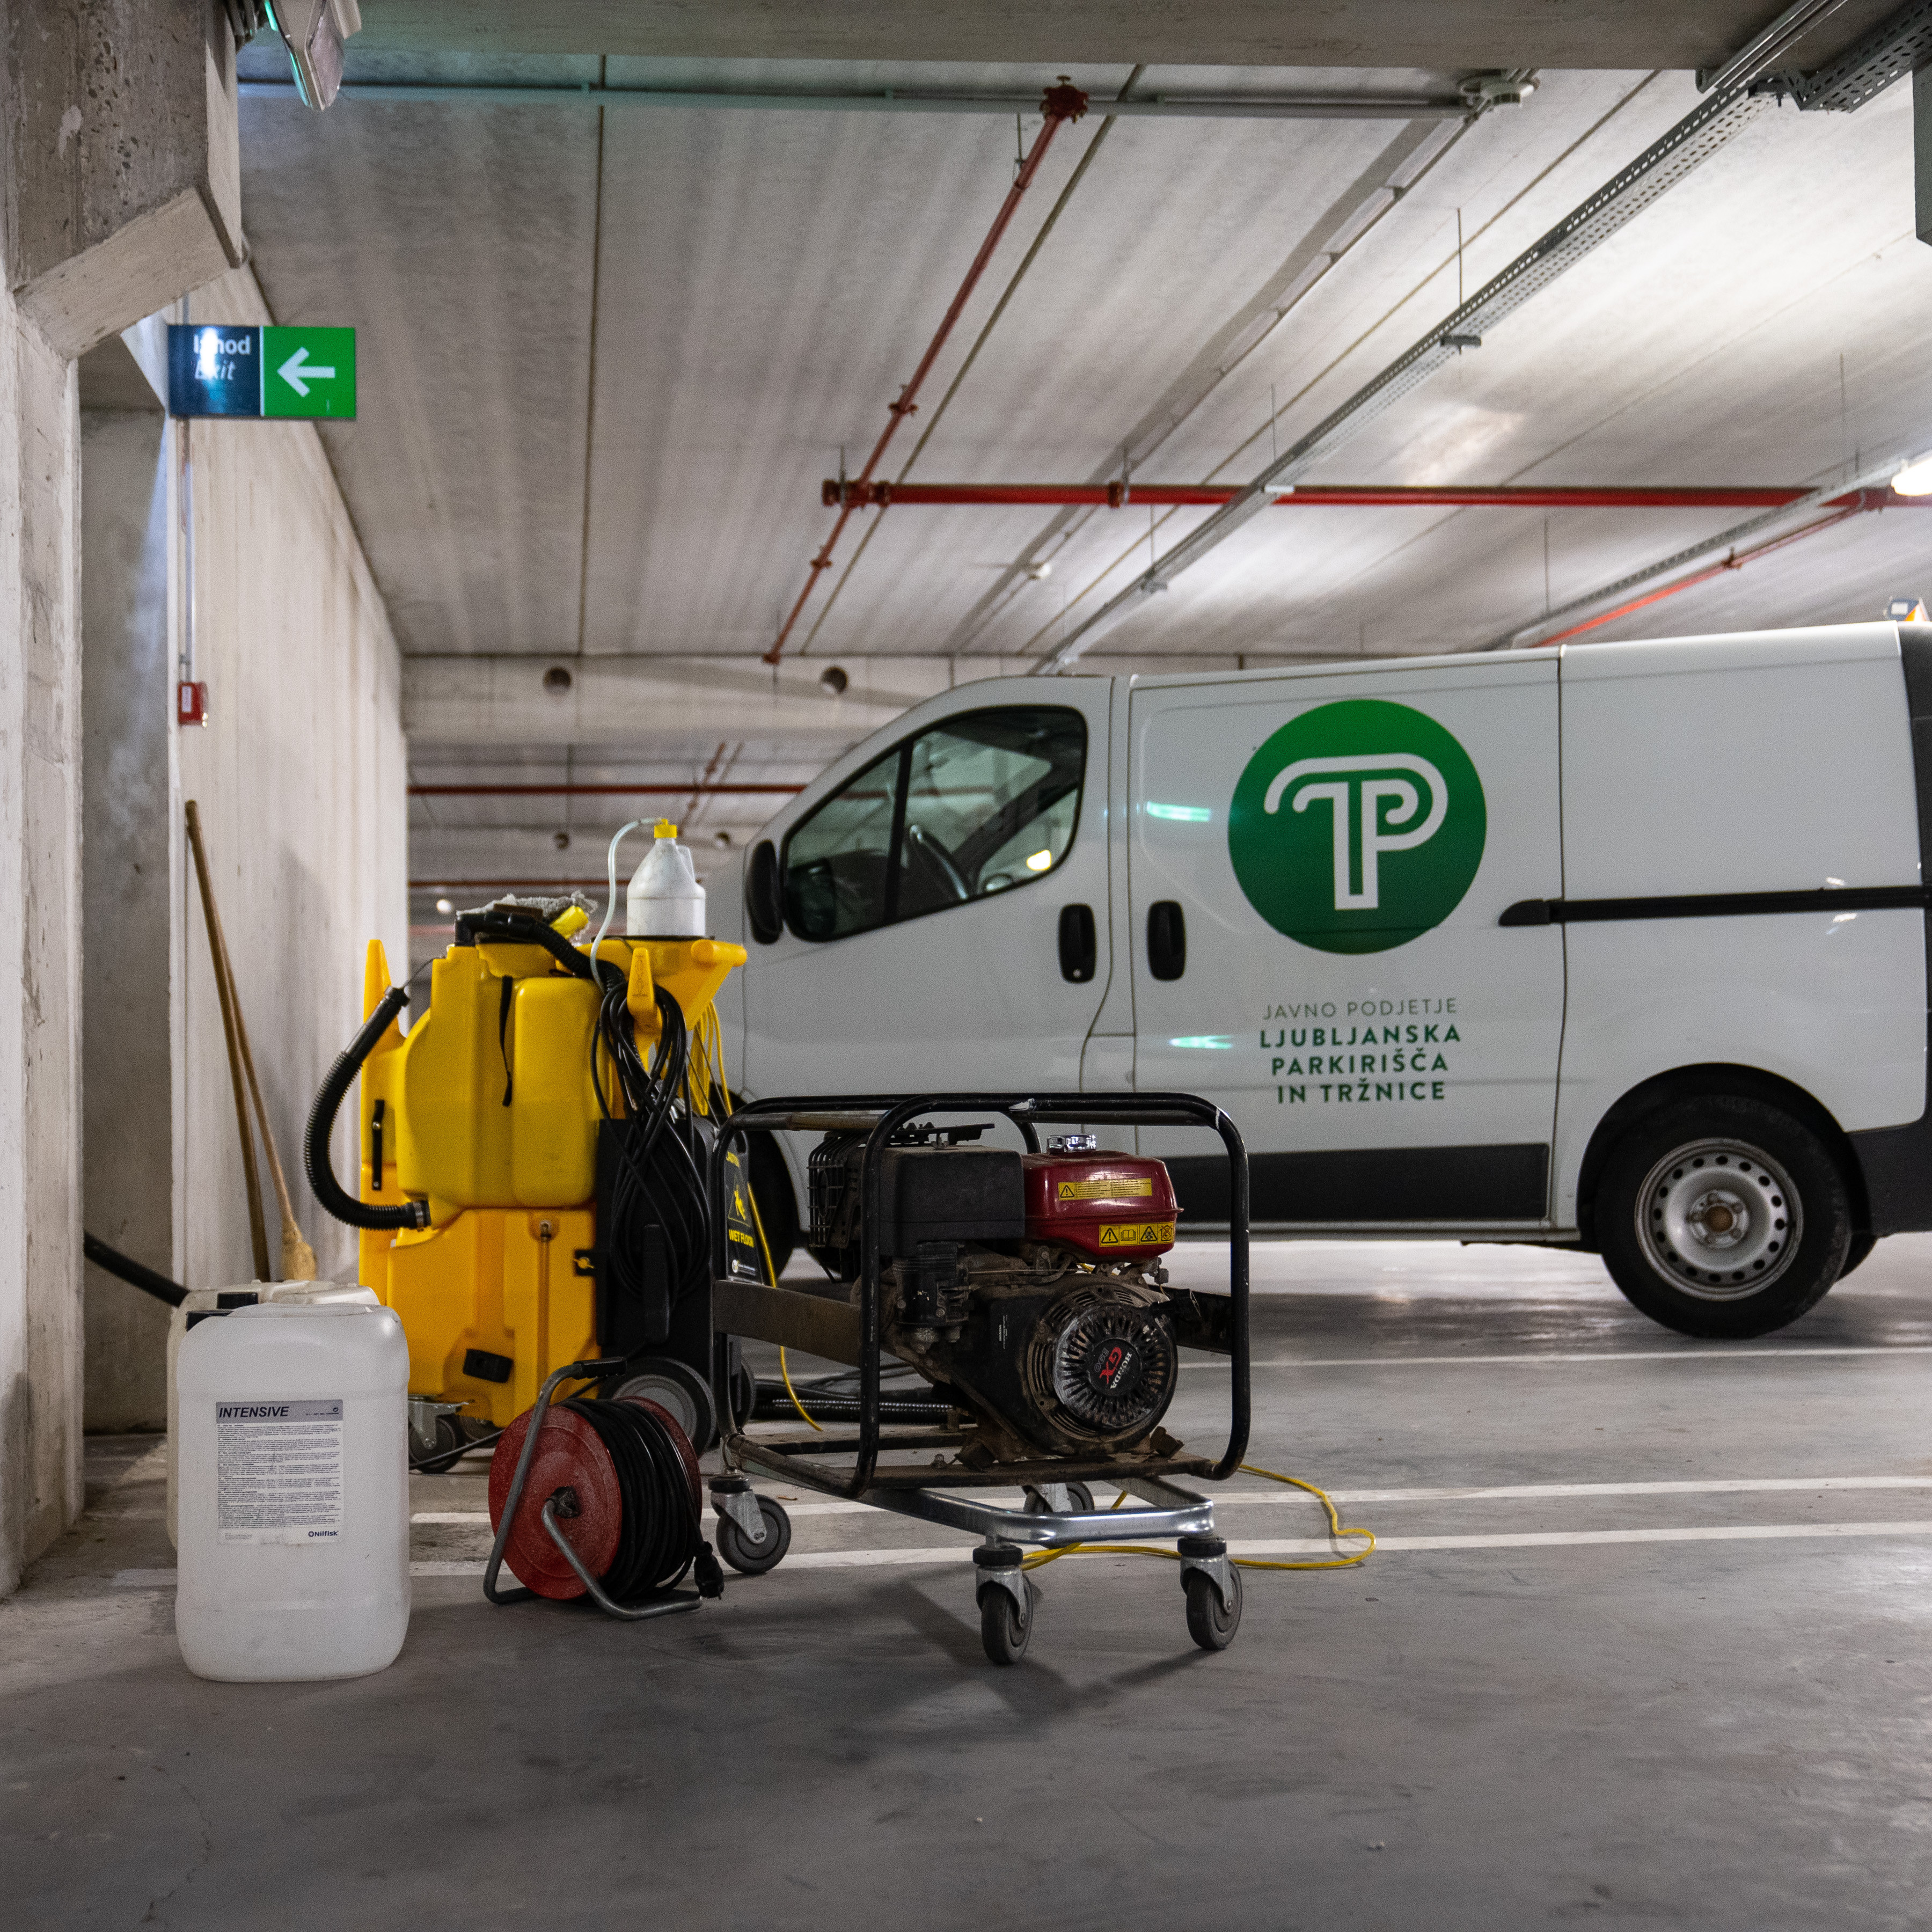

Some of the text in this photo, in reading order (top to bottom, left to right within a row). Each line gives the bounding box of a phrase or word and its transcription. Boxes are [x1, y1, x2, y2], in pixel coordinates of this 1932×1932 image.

[1263, 998, 1458, 1020] JAVNO PODJETJE
[1260, 1023, 1461, 1049] LJUBLJANSKA
[1271, 1048, 1448, 1075] PARKIRIŠČA
[1278, 1077, 1445, 1104] IN TRŽNICE
[1099, 1346, 1122, 1385] GX
[1109, 1351, 1132, 1389] HONDA
[219, 1406, 289, 1418] INTENSIVE
